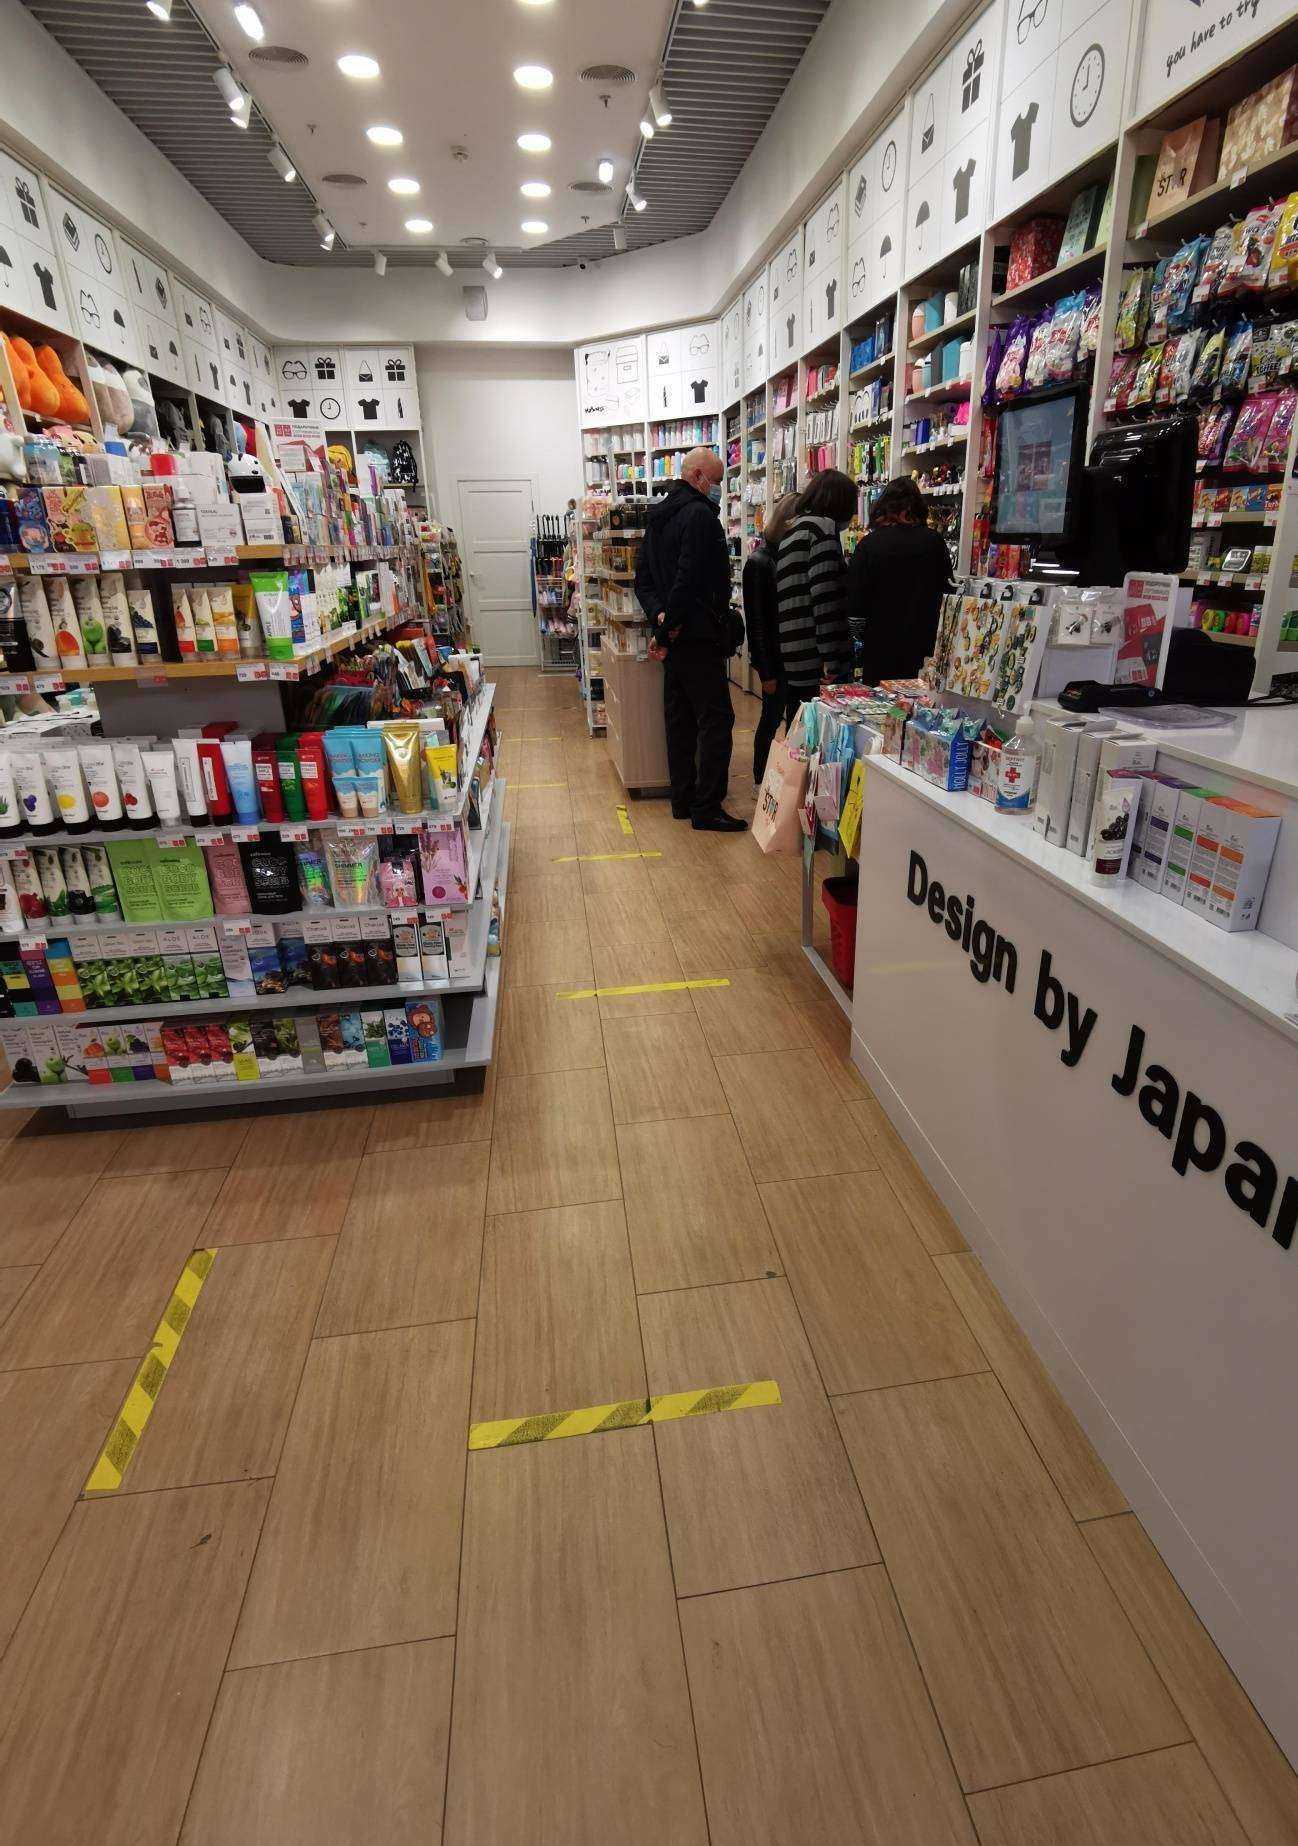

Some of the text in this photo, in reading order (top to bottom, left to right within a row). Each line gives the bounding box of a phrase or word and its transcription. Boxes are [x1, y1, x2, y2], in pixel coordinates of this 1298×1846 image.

[1166, 45, 1186, 78] you
[1190, 30, 1216, 53] have
[1218, 12, 1233, 29] to
[906, 849, 1018, 995] Design
[1033, 949, 1098, 1068] by
